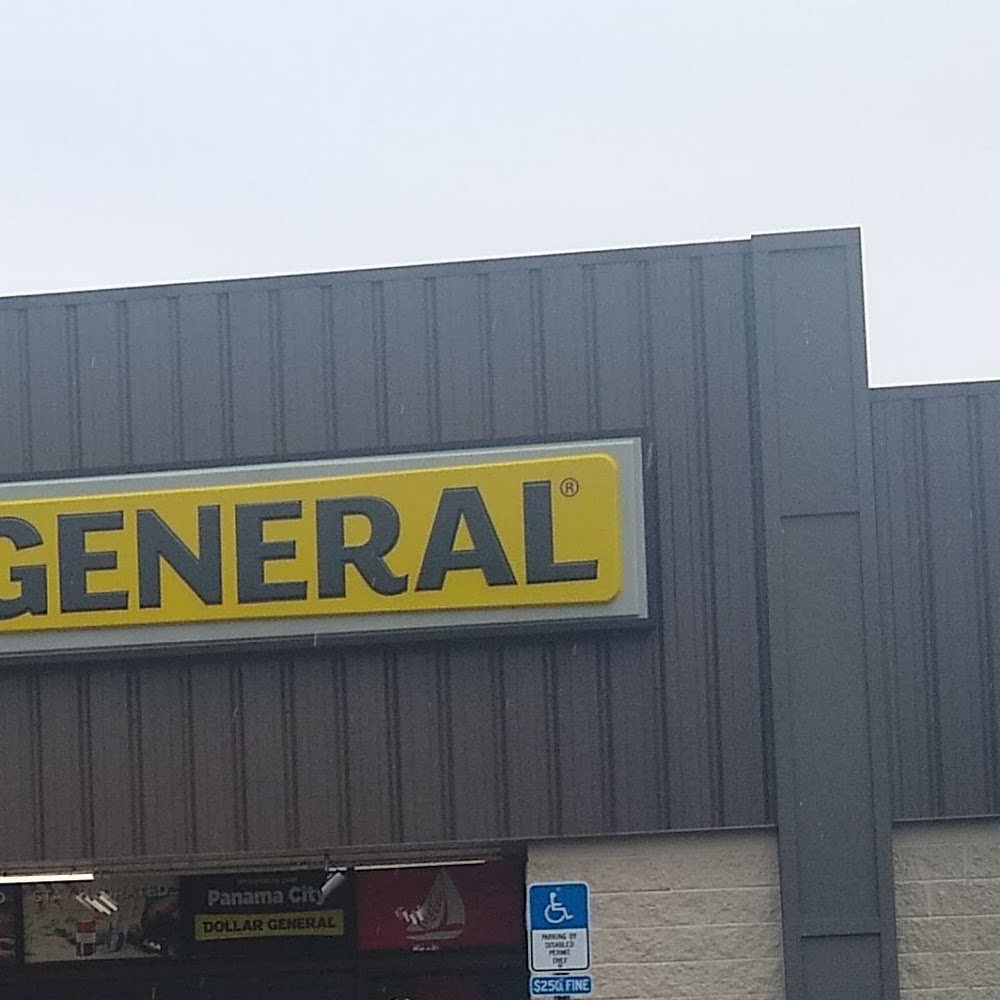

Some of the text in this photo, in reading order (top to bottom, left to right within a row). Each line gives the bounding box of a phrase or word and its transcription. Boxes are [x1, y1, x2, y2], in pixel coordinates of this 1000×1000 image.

[208, 884, 326, 907] Panama City
[202, 916, 337, 934] DOLLAR GENERAL
[533, 978, 590, 993] $250 FINE
